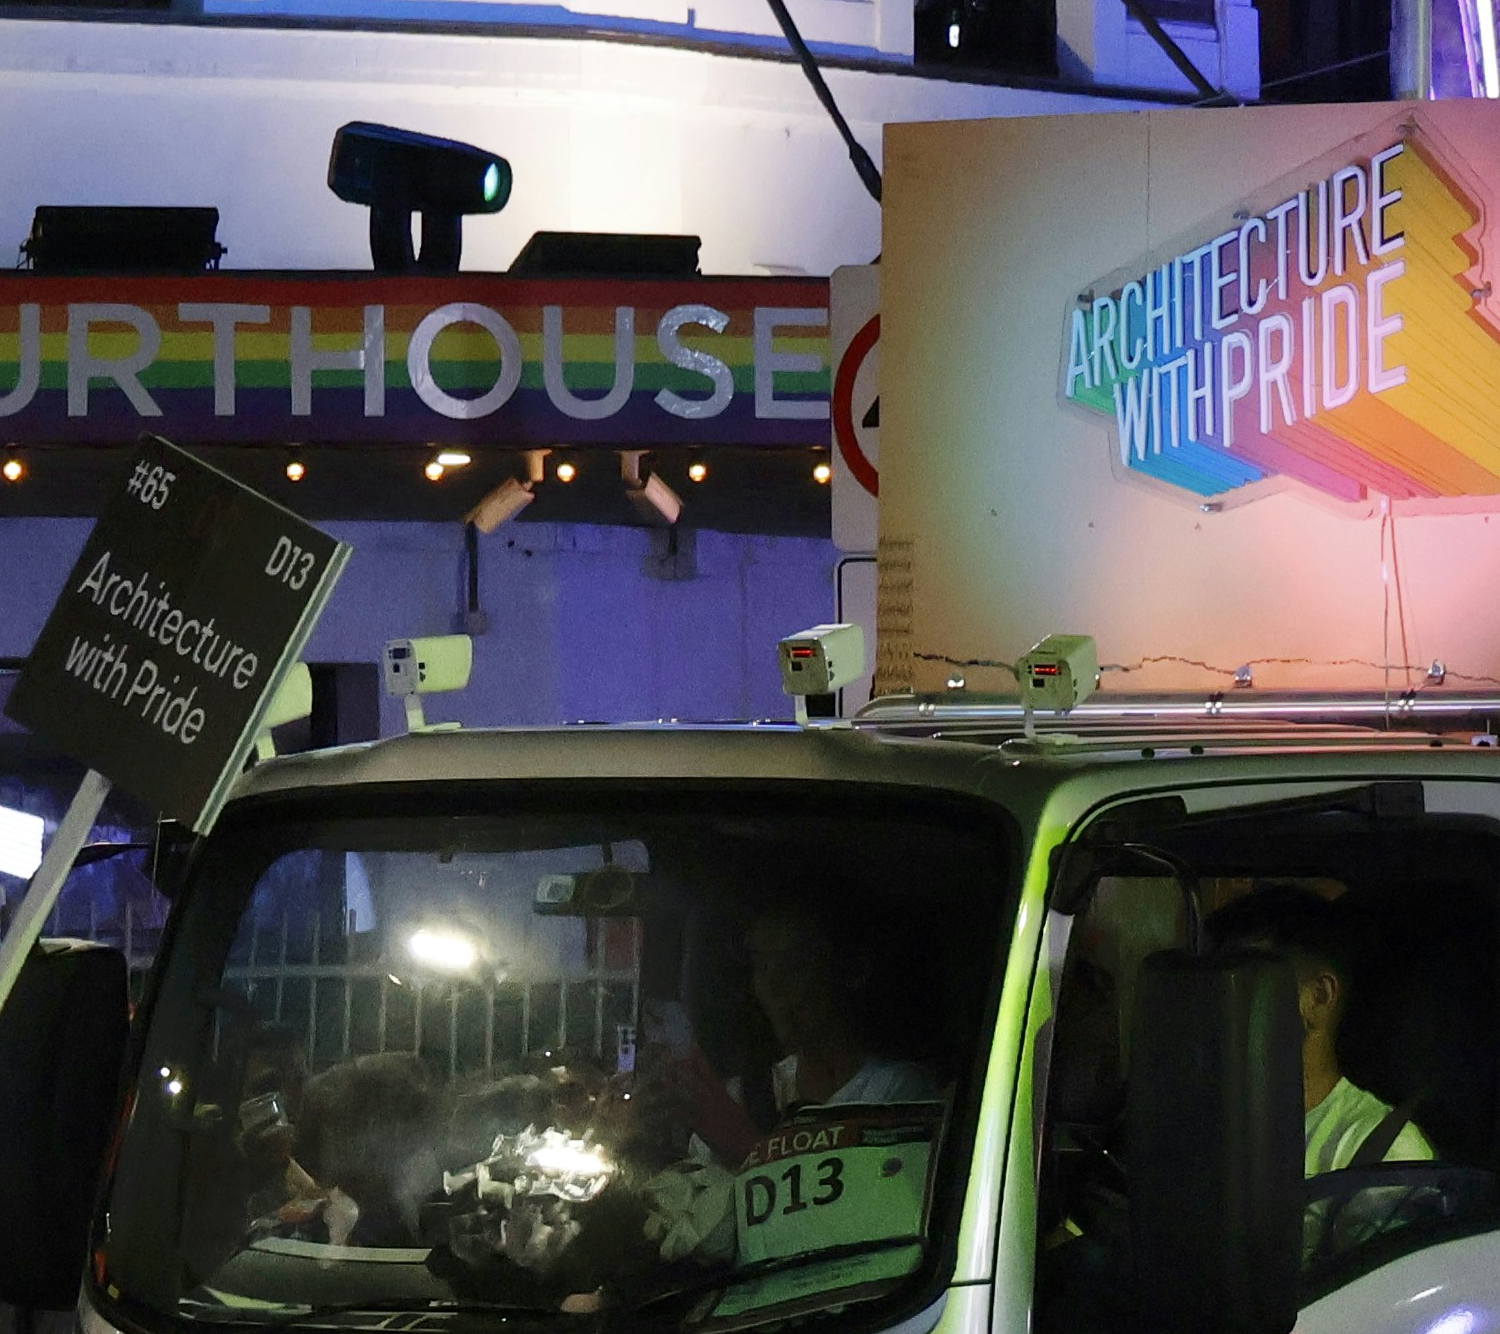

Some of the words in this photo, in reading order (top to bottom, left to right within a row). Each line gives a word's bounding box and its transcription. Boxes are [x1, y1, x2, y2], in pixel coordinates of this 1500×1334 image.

[1067, 141, 1406, 398] ARCHITECTURE
[1112, 342, 1214, 466] WITH
[1221, 259, 1408, 448] PRIDE
[125, 459, 178, 513] #65
[264, 533, 315, 592] D13
[76, 550, 262, 693] Architecture
[66, 633, 132, 709] with
[128, 663, 208, 745] Pride
[767, 1125, 846, 1161] FLOAT
[744, 1156, 845, 1228] D13
